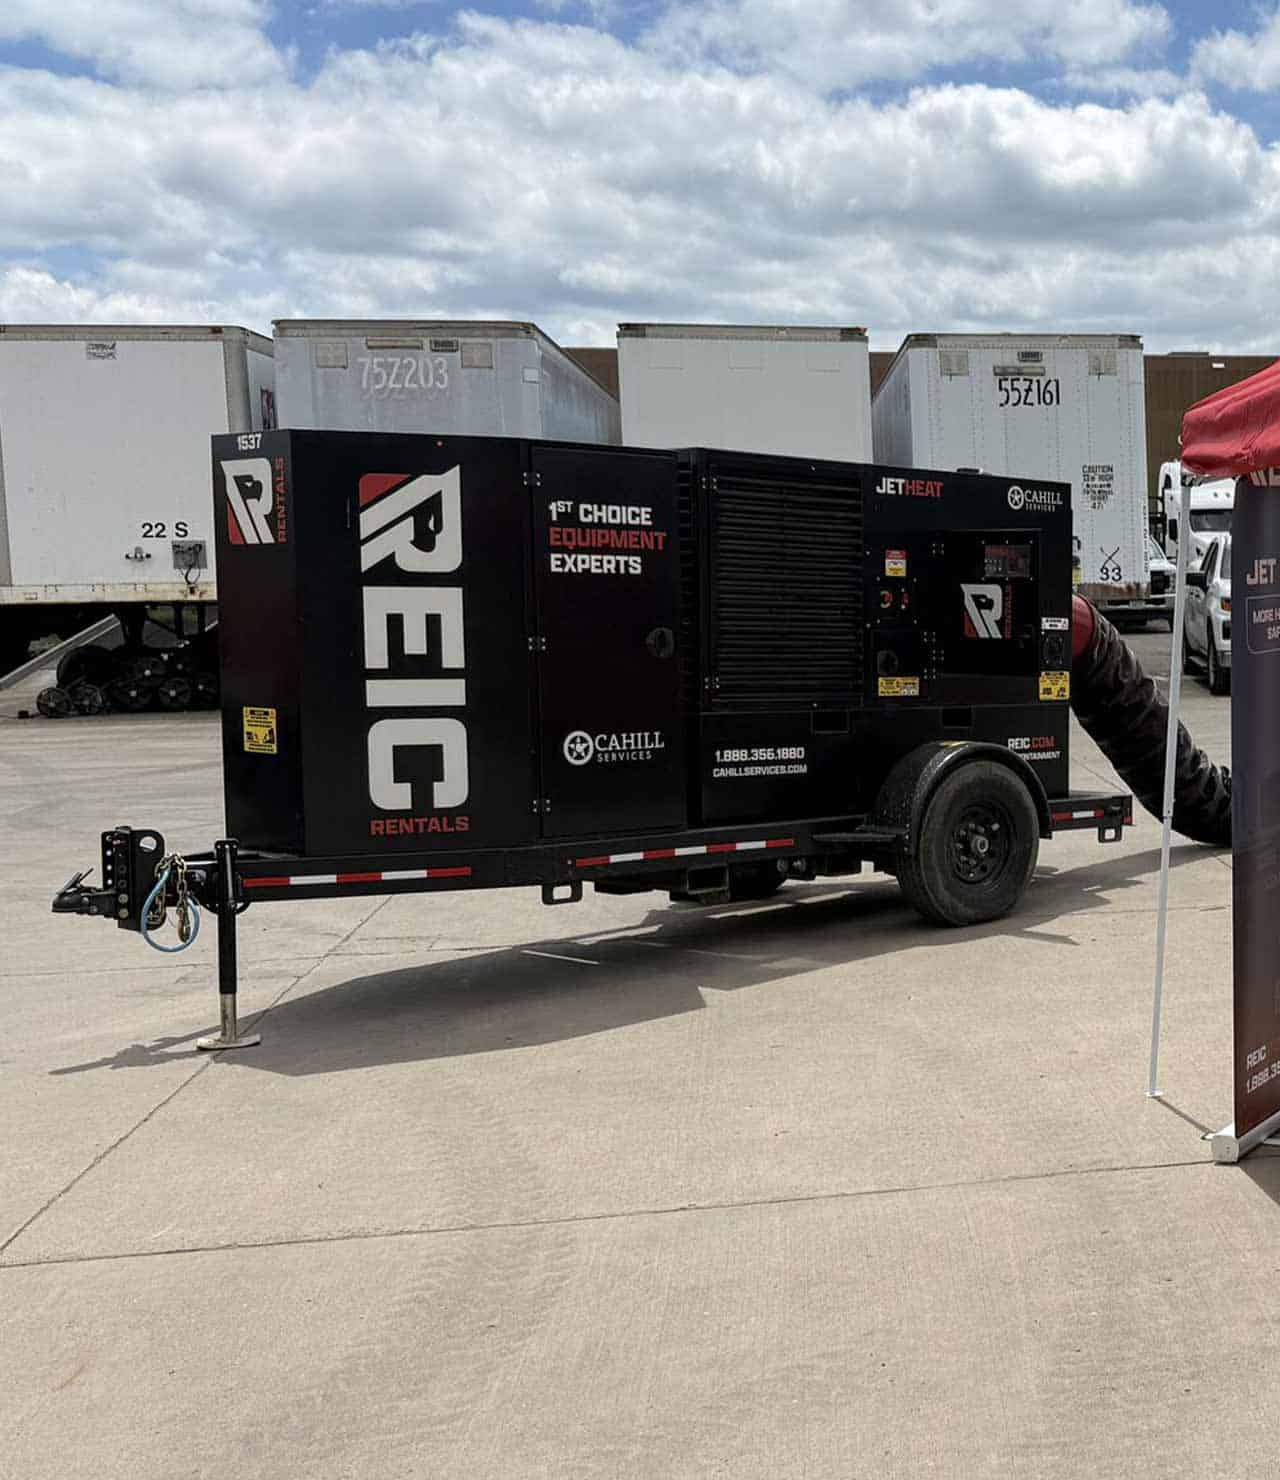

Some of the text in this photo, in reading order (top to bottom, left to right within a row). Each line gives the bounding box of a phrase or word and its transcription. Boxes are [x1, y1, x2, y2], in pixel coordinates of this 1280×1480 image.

[358, 356, 449, 390] 75Z203
[998, 377, 1060, 407] 55Z161
[237, 434, 262, 450] 1537
[1082, 464, 1114, 473] CAUTION
[276, 457, 288, 544] RENTALS
[1024, 489, 1063, 505] CAHILL
[579, 503, 653, 526] CHOICE
[141, 521, 189, 538] 22 S
[549, 527, 667, 550] EQUIPMENT
[550, 553, 642, 574] EXPERTS
[1246, 559, 1278, 584] JET
[1100, 567, 1122, 581] 33
[1253, 608, 1274, 624] MORE
[358, 464, 469, 811] REIC
[594, 731, 665, 751] CAHILL
[597, 751, 653, 763] SERVICES
[715, 746, 806, 763] 1.888.356.1880
[712, 764, 808, 778] CAHILLSERVICES.COM
[370, 816, 470, 836] RENTALS
[1247, 1045, 1266, 1071] REIC
